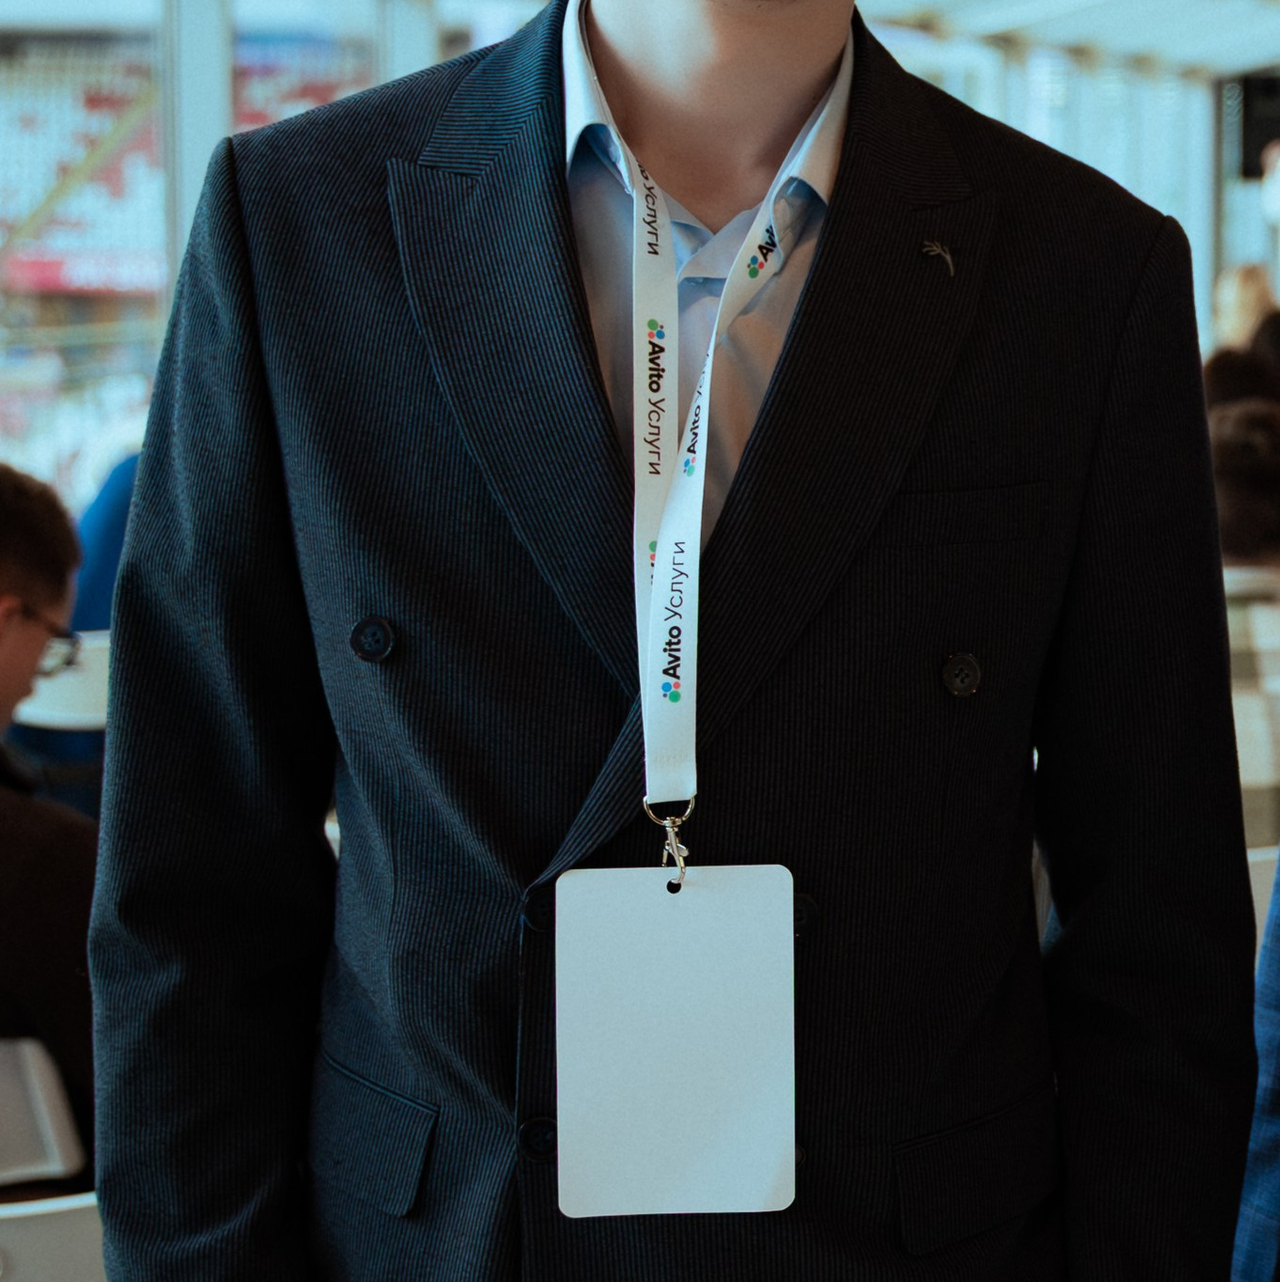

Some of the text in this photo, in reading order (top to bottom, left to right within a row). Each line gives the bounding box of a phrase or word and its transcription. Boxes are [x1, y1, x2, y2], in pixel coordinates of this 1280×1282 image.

[642, 182, 660, 256] Услуги
[757, 225, 777, 263] Avi
[644, 340, 666, 475] Avito Услуги
[687, 405, 701, 454] Avito
[662, 541, 689, 680] Avito Услуги
